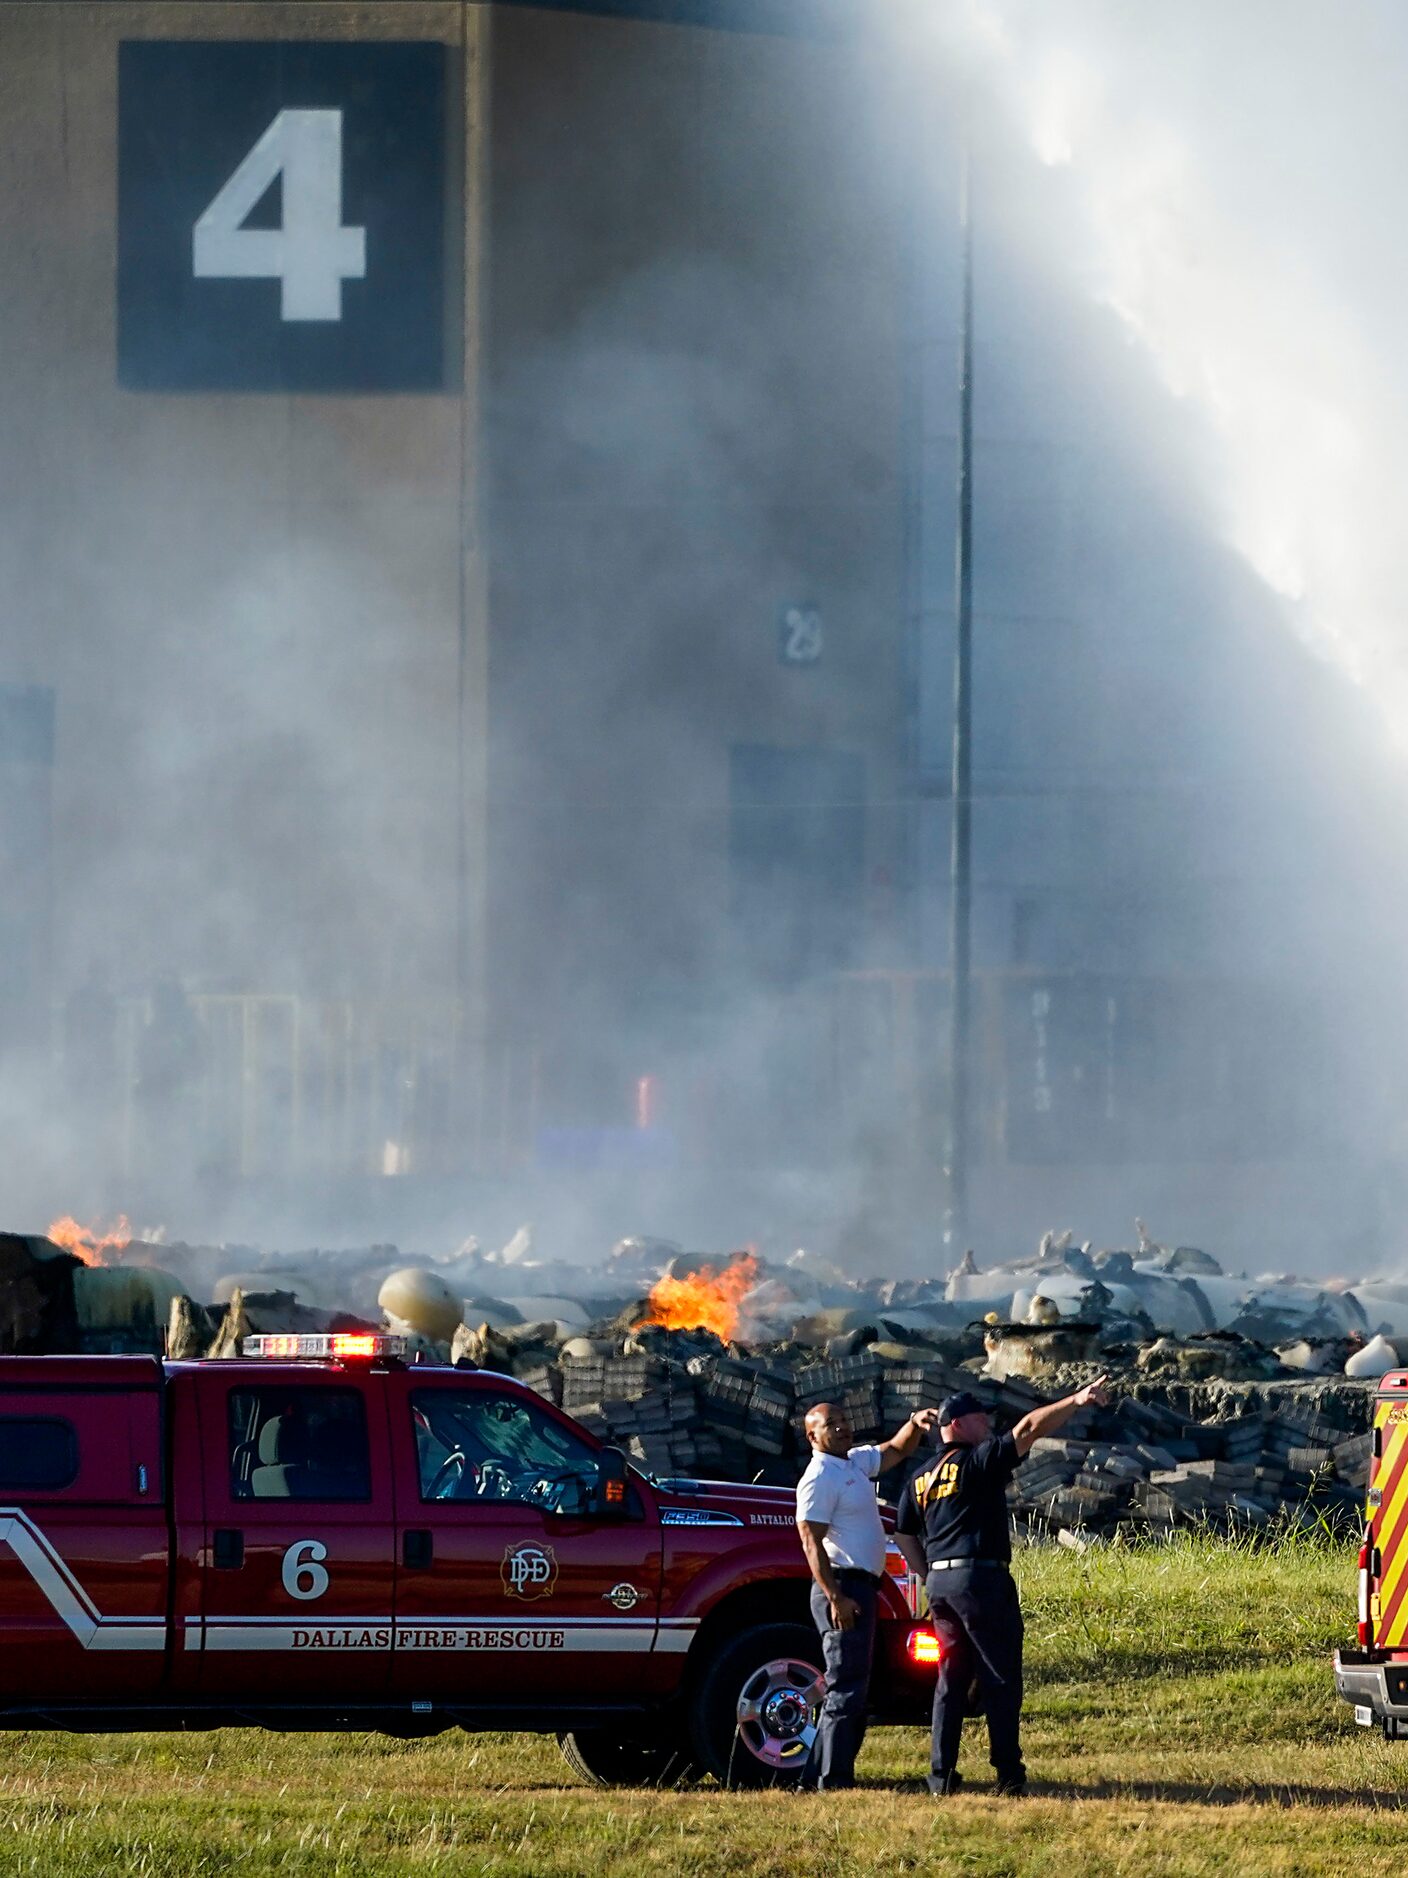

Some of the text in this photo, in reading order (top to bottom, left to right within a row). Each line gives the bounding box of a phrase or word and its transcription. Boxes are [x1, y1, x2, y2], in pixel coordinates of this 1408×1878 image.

[193, 109, 366, 321] 4
[281, 1539, 330, 1600] 6
[291, 1630, 565, 1649] DALLAS FIRE-RESCUE
